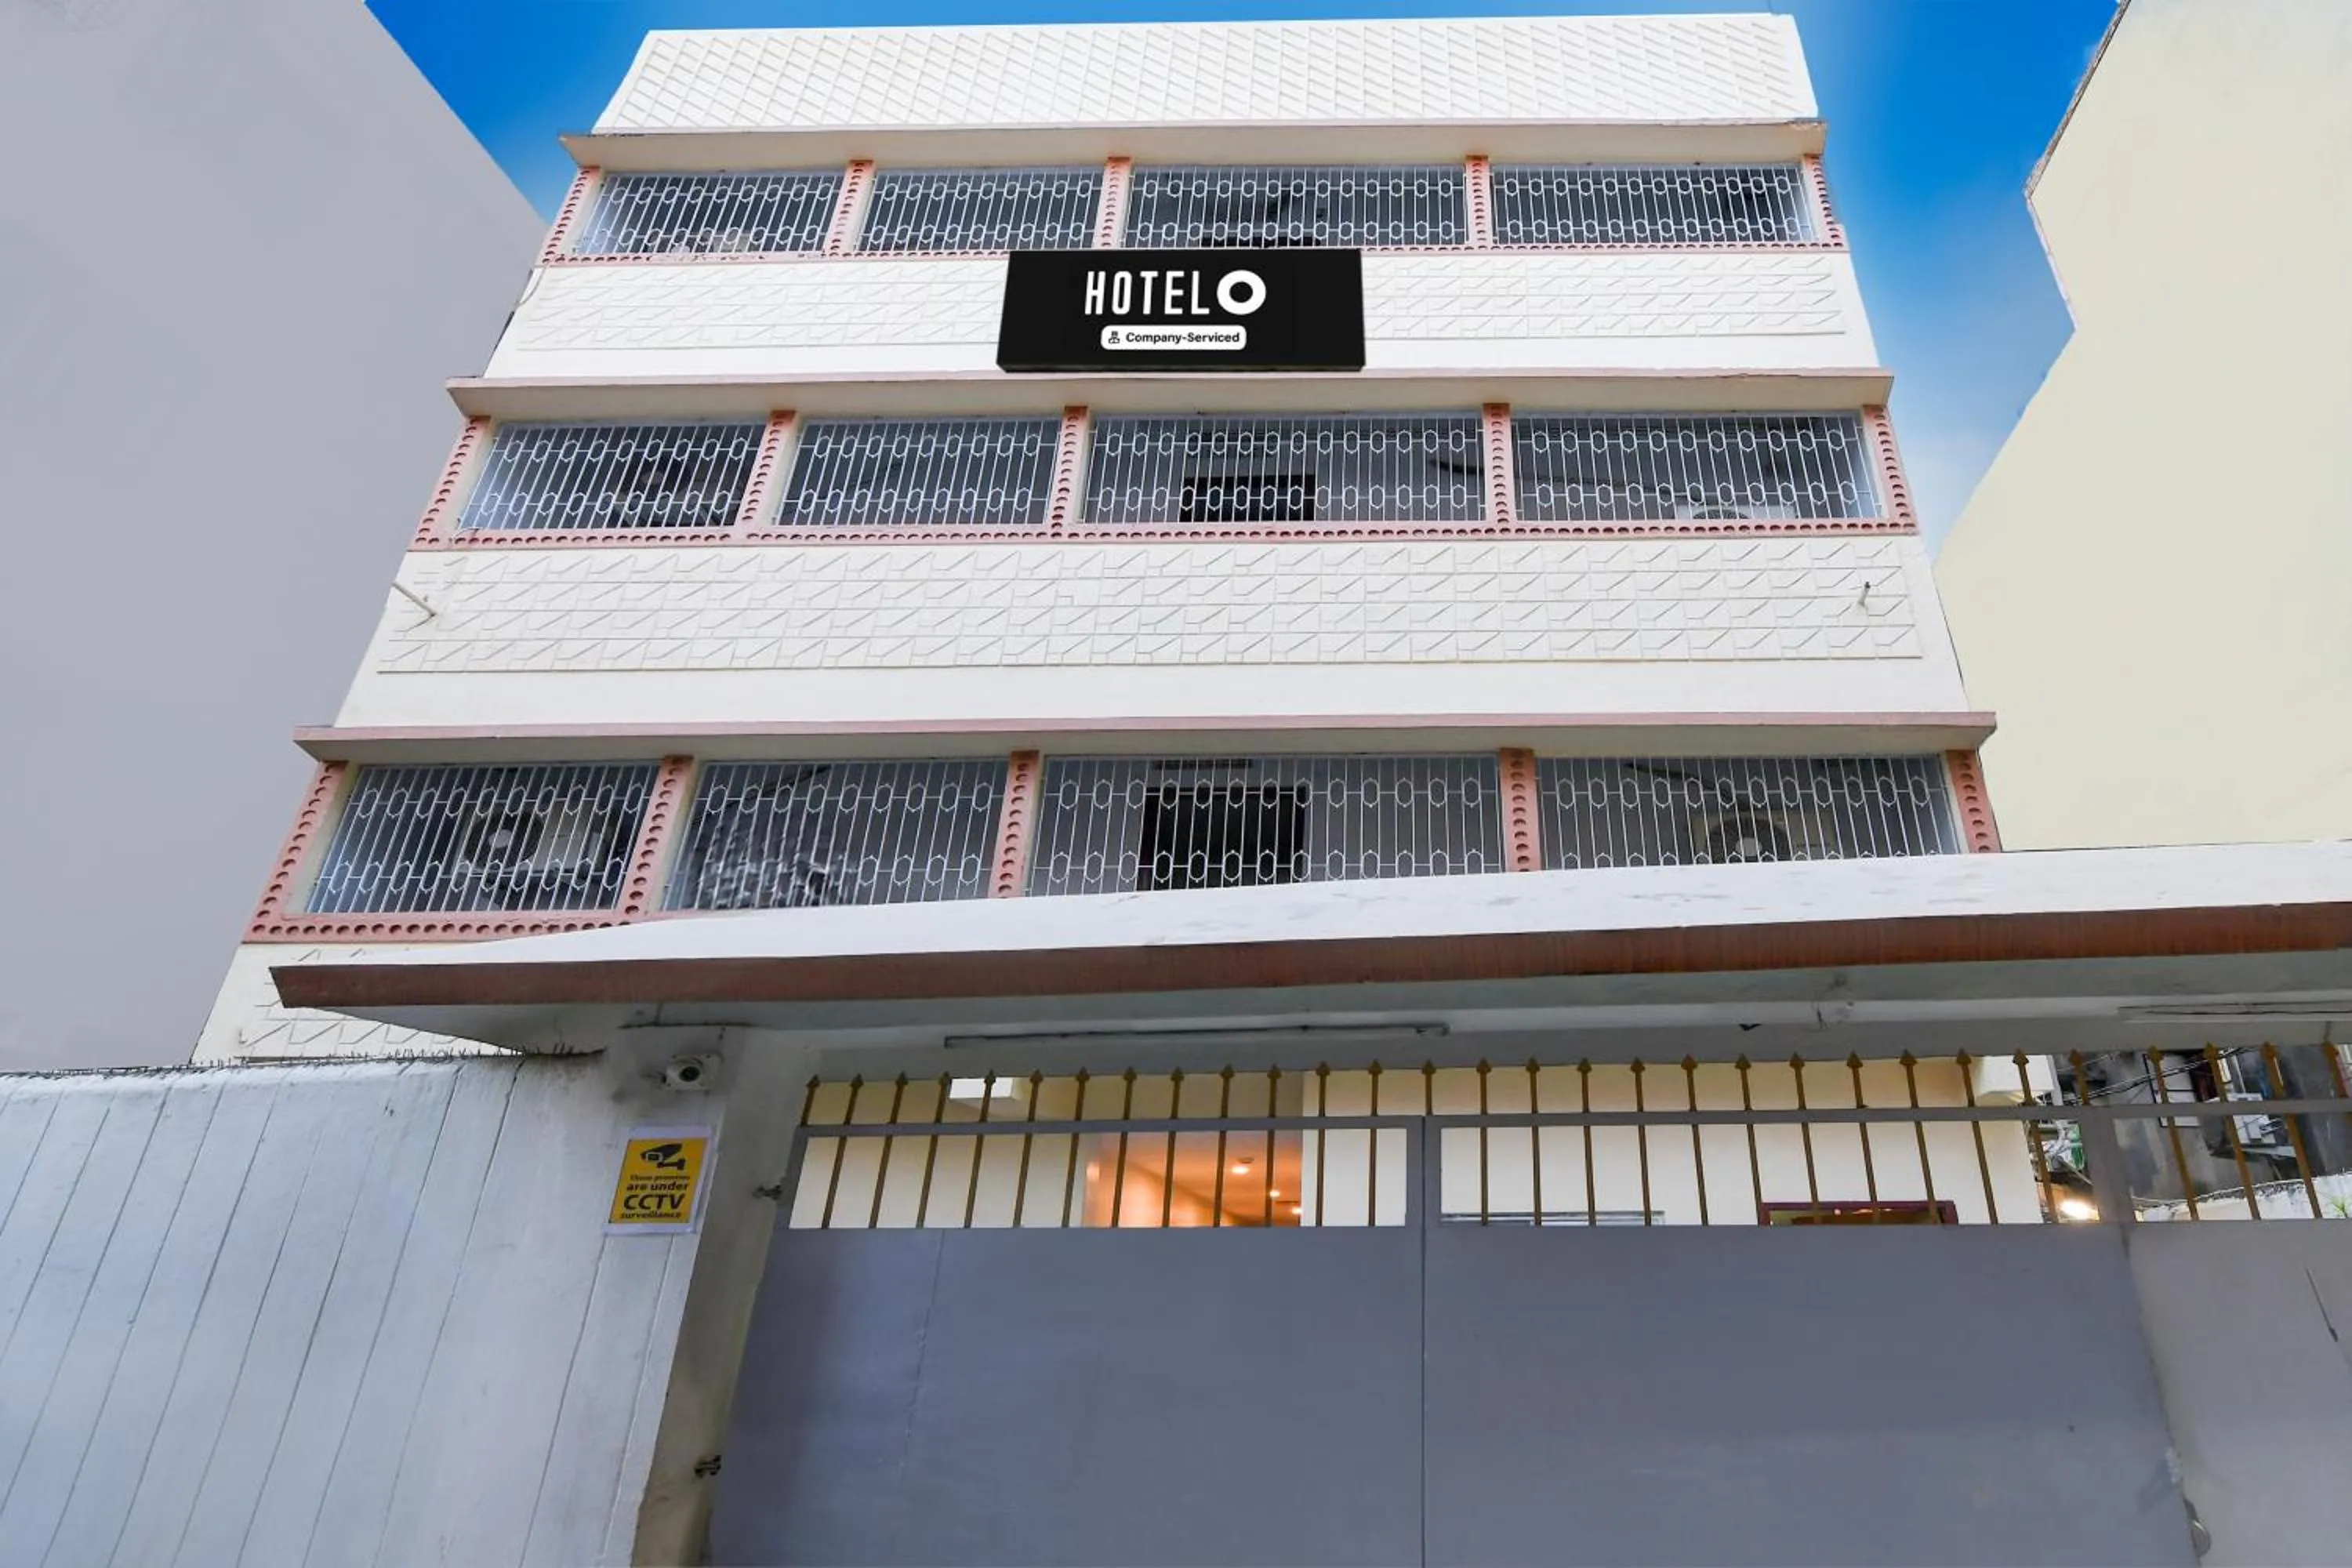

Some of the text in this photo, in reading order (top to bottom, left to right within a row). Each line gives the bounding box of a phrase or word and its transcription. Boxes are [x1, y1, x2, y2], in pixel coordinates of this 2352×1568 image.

[1084, 270, 1210, 315] HOTEL
[1126, 332, 1240, 344] Company-Serviced
[650, 1181, 688, 1190] under
[623, 1193, 685, 1209] CCTV
